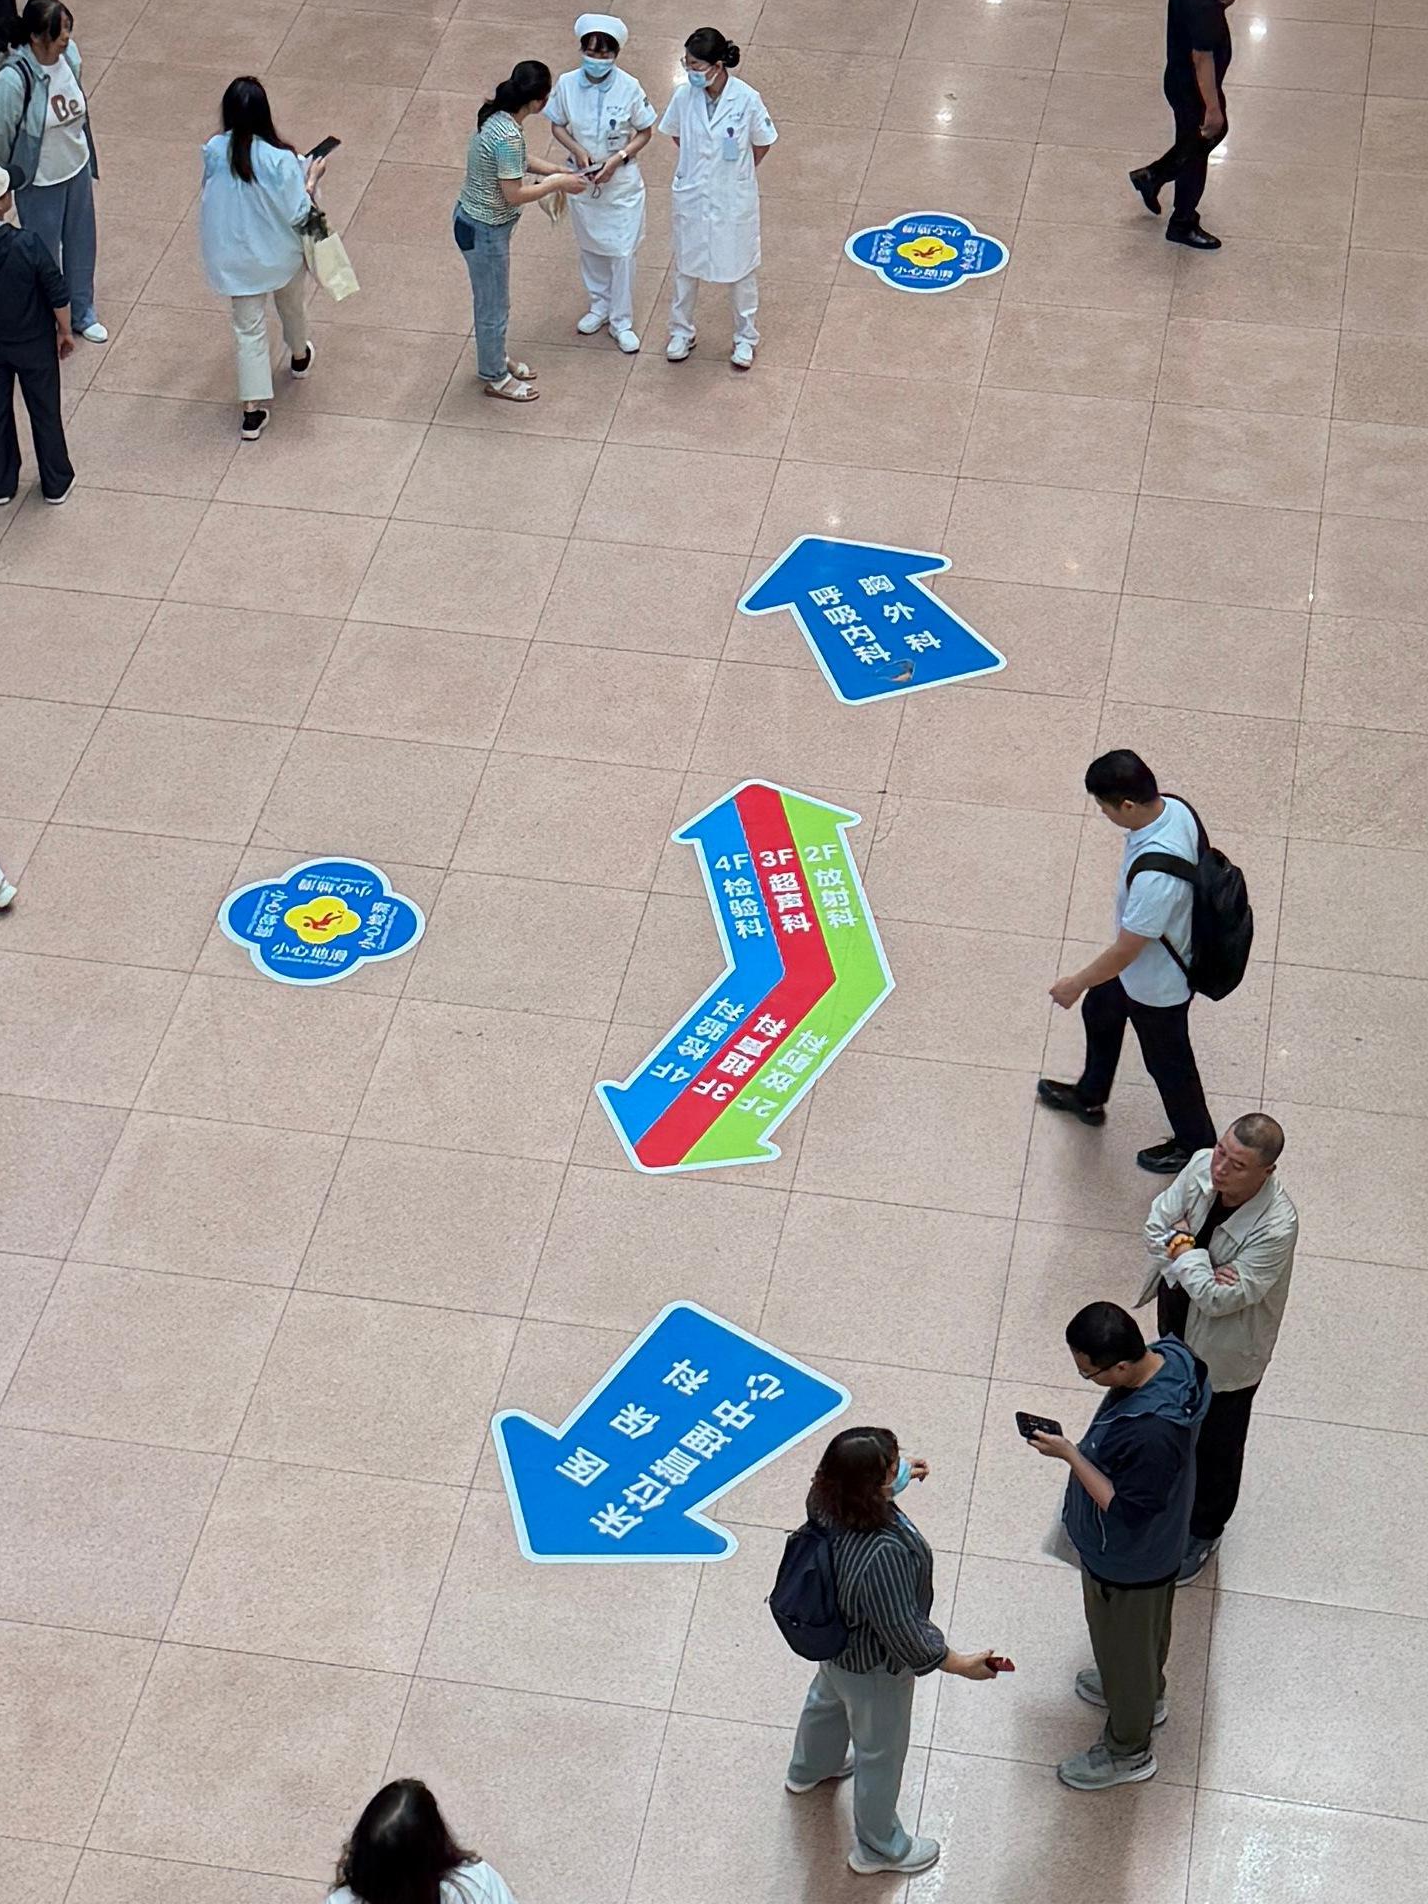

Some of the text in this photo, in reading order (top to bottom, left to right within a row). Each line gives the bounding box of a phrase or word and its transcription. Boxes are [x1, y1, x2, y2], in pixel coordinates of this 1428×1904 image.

[808, 585, 892, 666] 呼吸内科
[858, 574, 942, 653] 胸外科
[715, 853, 766, 940] 4F 检验科
[759, 848, 813, 934] 3F 超声科
[804, 843, 858, 930] 2F 放射科
[272, 942, 348, 963] 小心地滑
[649, 997, 745, 1084] 4F 检验科
[691, 1013, 788, 1102] 3F 超声科
[736, 1028, 830, 1118] 2F 放射科
[555, 1358, 711, 1487] 医保科
[589, 1372, 785, 1540] 床位管理中心
